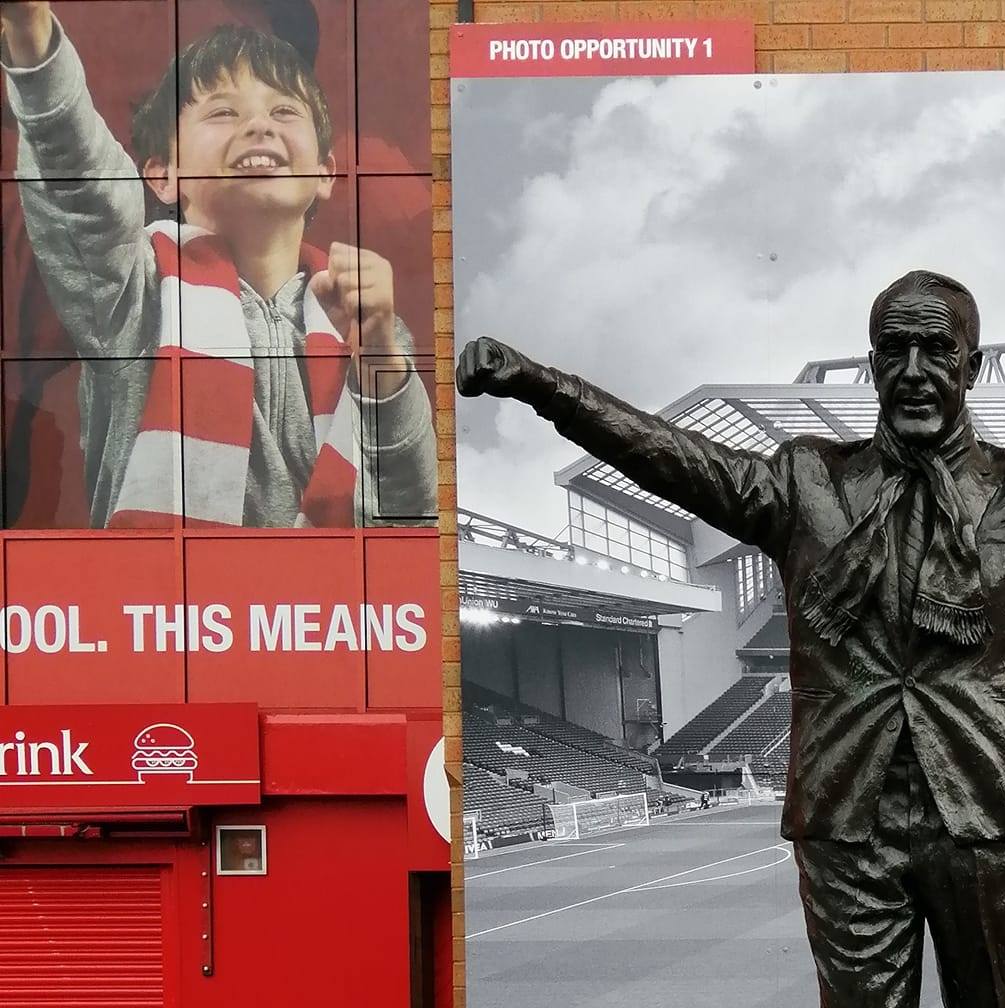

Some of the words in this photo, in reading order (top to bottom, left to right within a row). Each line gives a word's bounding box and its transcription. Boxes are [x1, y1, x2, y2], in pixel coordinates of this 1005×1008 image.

[489, 39, 554, 60] PHOTO
[561, 38, 698, 60] OPPORTUNITY
[703, 38, 713, 58] 1
[123, 604, 234, 653] THIS
[250, 603, 427, 653] MEANS
[595, 613, 622, 625] Standard
[622, 616, 649, 628] Chartered
[0, 728, 95, 776] rink
